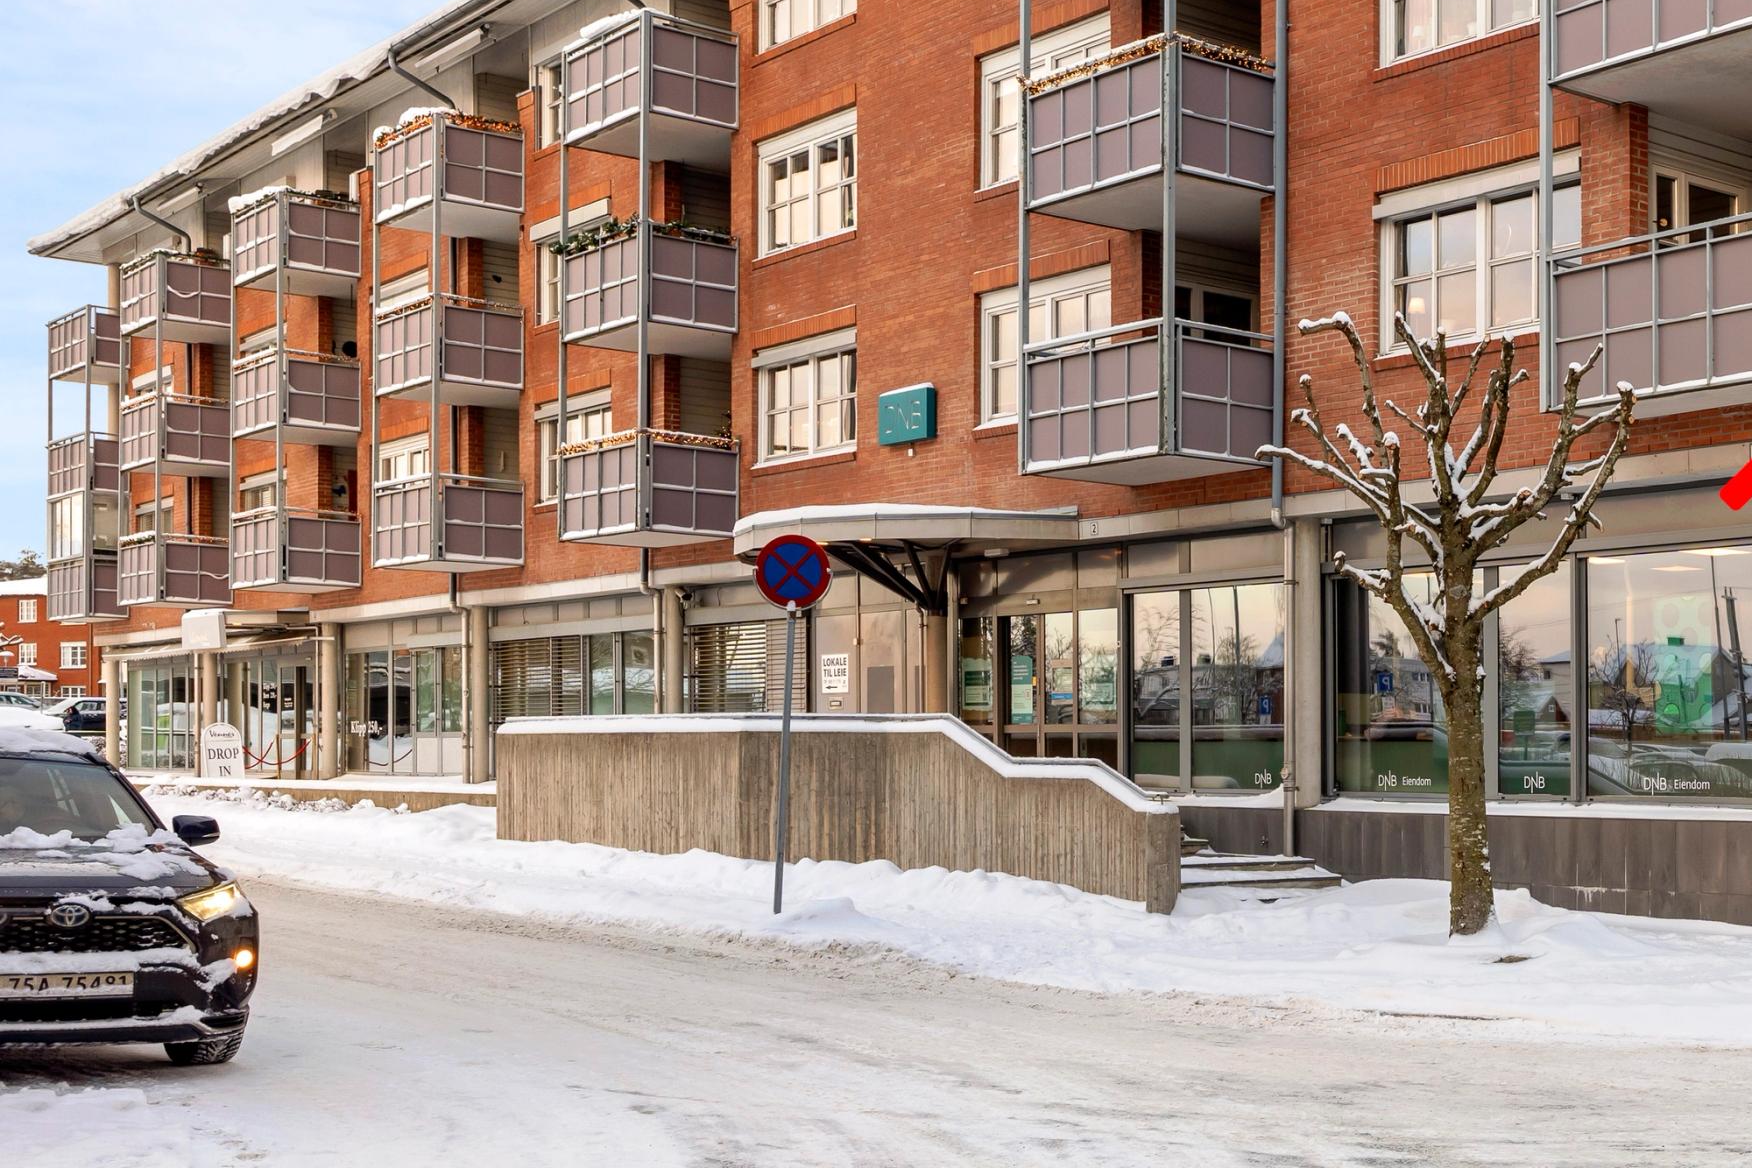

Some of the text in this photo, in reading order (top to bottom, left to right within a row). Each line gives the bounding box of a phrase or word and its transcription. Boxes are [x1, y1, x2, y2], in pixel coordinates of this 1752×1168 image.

[823, 657, 847, 667] LOKALE
[823, 668, 847, 678] TIL LEIE
[208, 747, 240, 760] DROP
[219, 765, 232, 777] IN
[1254, 769, 1272, 789] DNB
[1378, 770, 1432, 791] DNB Eiendom
[1523, 771, 1546, 794] DNB
[1643, 771, 1711, 796] DNB Eiendom
